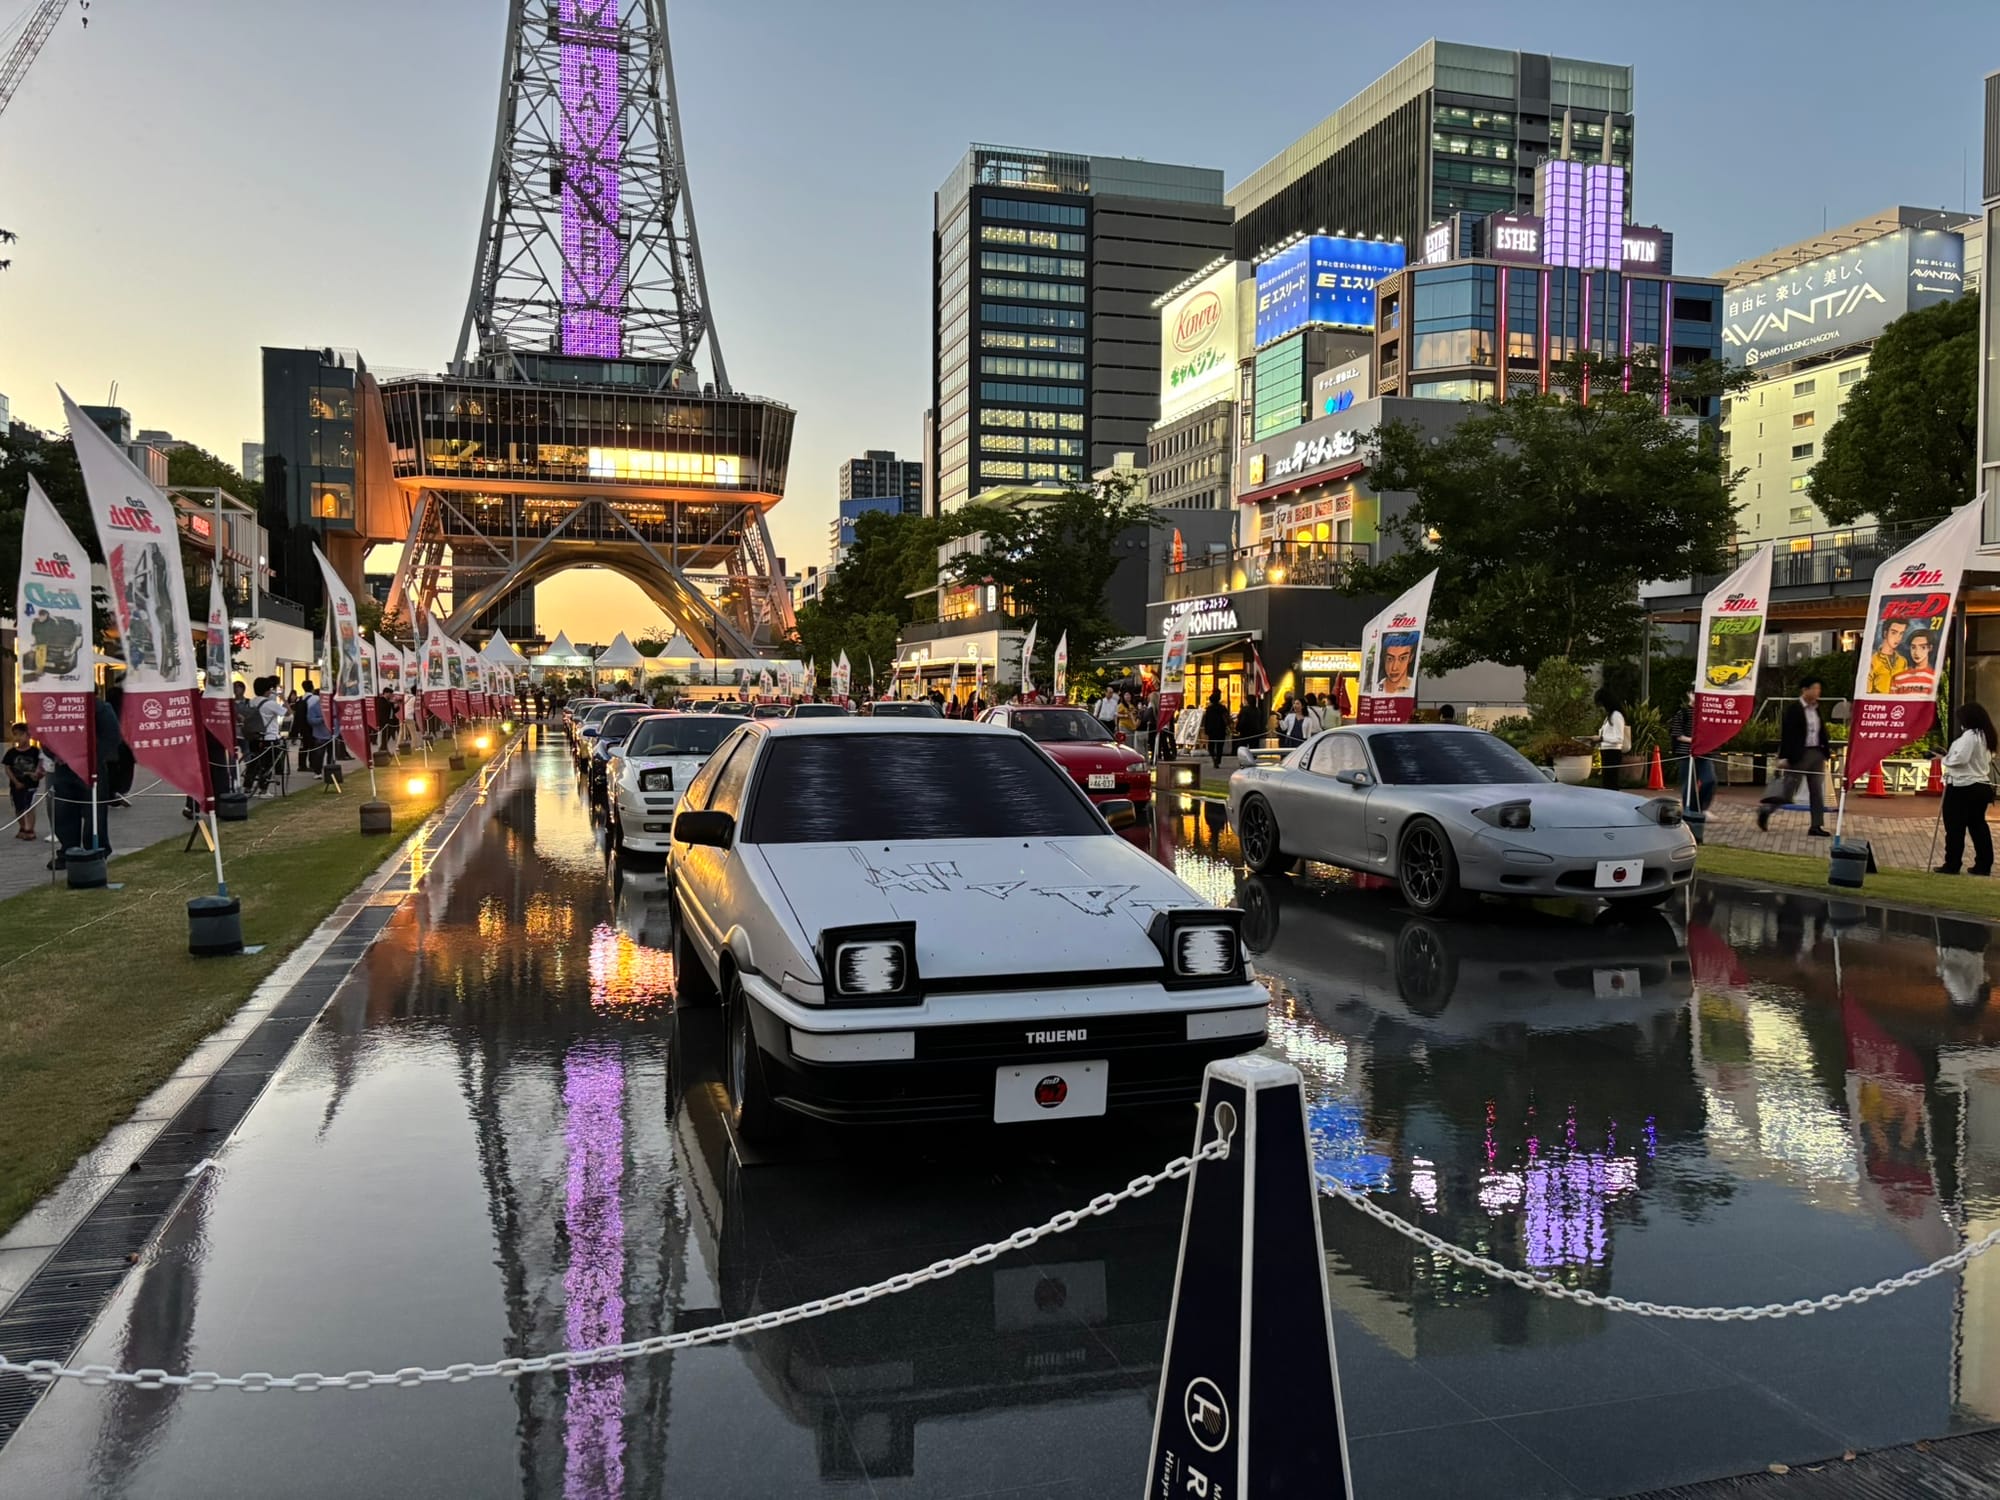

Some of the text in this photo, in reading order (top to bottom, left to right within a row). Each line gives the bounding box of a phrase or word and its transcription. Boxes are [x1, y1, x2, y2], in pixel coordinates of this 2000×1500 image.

[1426, 226, 1449, 253] ESTHE
[1496, 227, 1538, 252] ESTHE
[1622, 239, 1656, 262] TWIN
[1271, 275, 1306, 305] エスリード
[1340, 275, 1376, 291] エスリ
[1729, 258, 1864, 319] 自由に 楽しく 美しく
[1175, 301, 1218, 344] Kowa
[1758, 330, 1840, 361] SANYO HOUSING NAGOYA
[1890, 569, 1944, 589] 30th
[1718, 598, 1759, 612] 30th
[1163, 609, 1238, 636] SHONTHA
[1929, 616, 1943, 631] 27
[1863, 704, 1887, 712] COPPA
[1025, 1029, 1087, 1044] TRUENO
[1186, 1464, 1208, 1498] R
